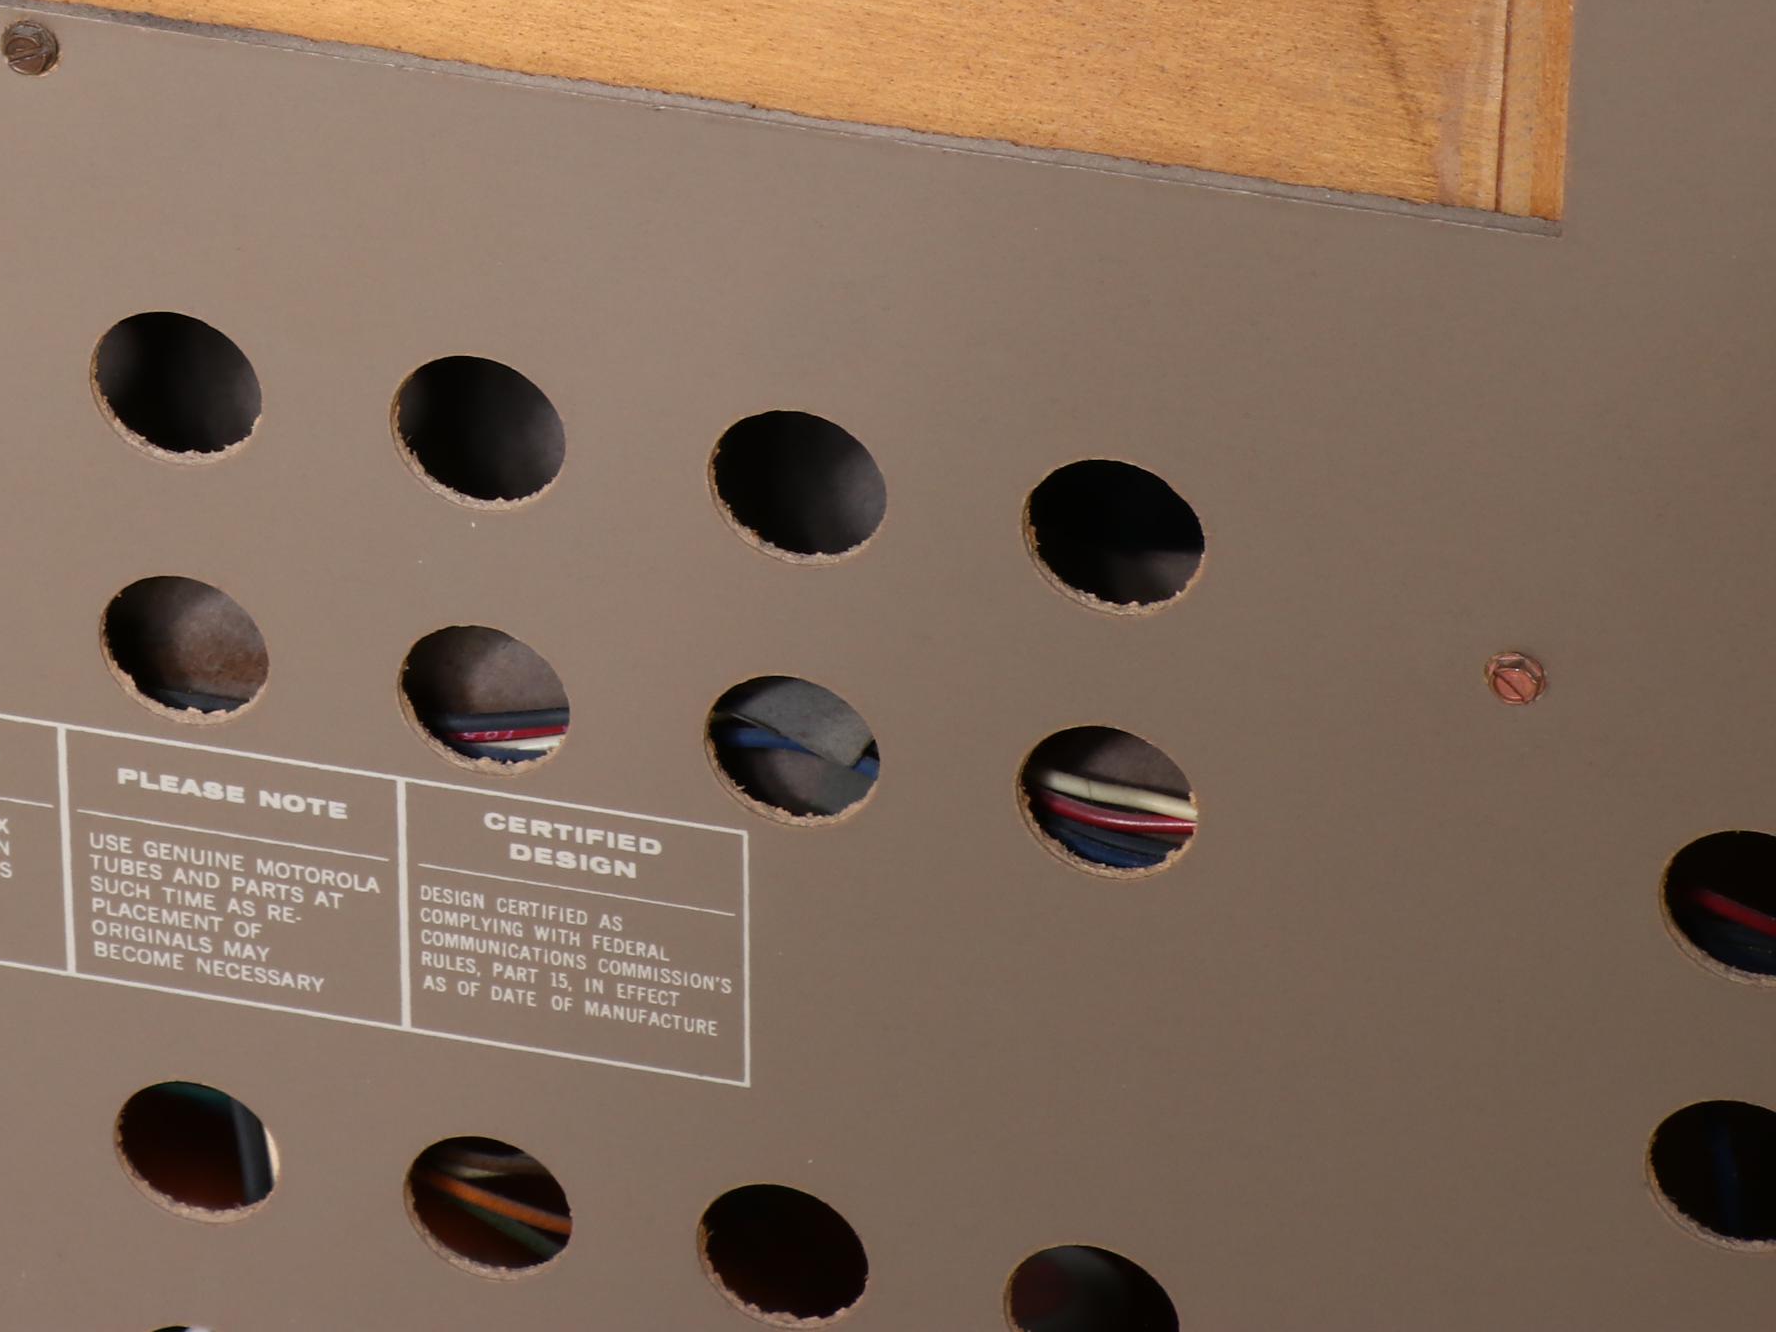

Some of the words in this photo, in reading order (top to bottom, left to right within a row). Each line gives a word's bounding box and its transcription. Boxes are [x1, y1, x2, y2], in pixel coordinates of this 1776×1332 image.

[117, 767, 244, 803] PLEASE
[259, 790, 347, 819] NOTE
[483, 812, 661, 854] CERTIFIED
[89, 832, 132, 853] USE
[142, 840, 243, 871] GENUINE
[256, 858, 380, 893] MOTOROLA
[89, 854, 162, 880] TUBES
[172, 867, 219, 888] AND
[231, 876, 303, 902] PARTS
[314, 890, 343, 908] AT
[509, 843, 635, 878] DESIGN
[90, 875, 149, 899] SUCH
[161, 886, 216, 910] TIME
[227, 897, 255, 916] AS
[267, 903, 300, 923] RE-
[92, 897, 223, 932] PLACEMENT
[234, 920, 261, 938] OF
[420, 884, 484, 908] DESIGN
[496, 897, 587, 925] CERTIFIED
[599, 913, 622, 931] AS
[91, 919, 212, 953] ORIGINALS
[223, 940, 269, 961] MAY
[420, 907, 522, 937] COMPLYING
[533, 925, 579, 946] WITH
[592, 934, 669, 961] FEDERAL
[94, 940, 183, 970] BECOME
[196, 957, 324, 991] NECESSARY
[420, 929, 586, 969] COMMUNICATIONS
[598, 958, 731, 993] COMMISSION'S
[492, 961, 538, 983] PART
[585, 977, 603, 994] IN
[616, 983, 680, 1006] EFFECT
[423, 975, 446, 991] AS
[457, 980, 480, 996] OF
[491, 985, 536, 1006] DATE
[551, 995, 572, 1011] OF
[584, 999, 716, 1036] MANUFACTURE
